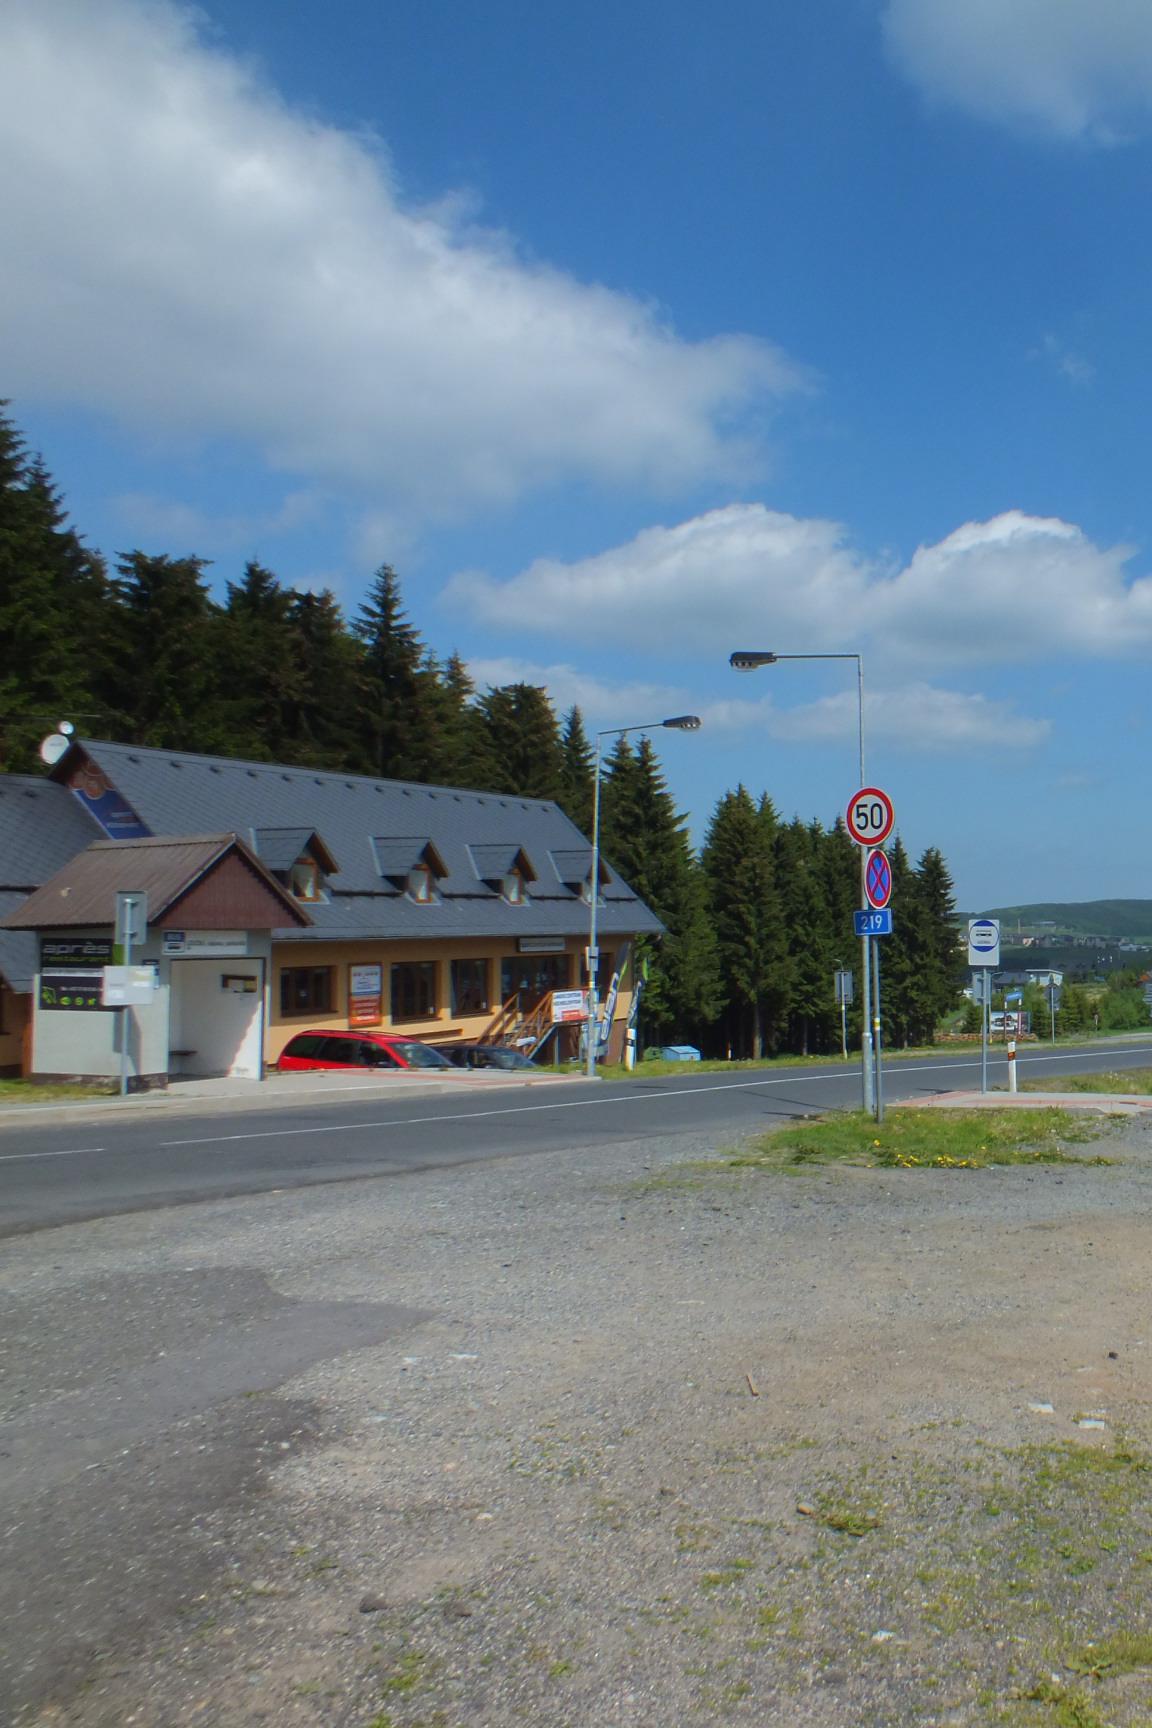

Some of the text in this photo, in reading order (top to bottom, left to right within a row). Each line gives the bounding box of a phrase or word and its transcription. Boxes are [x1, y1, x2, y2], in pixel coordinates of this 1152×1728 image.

[856, 803, 883, 830] 50
[861, 914, 882, 930] 219
[43, 941, 110, 956] après
